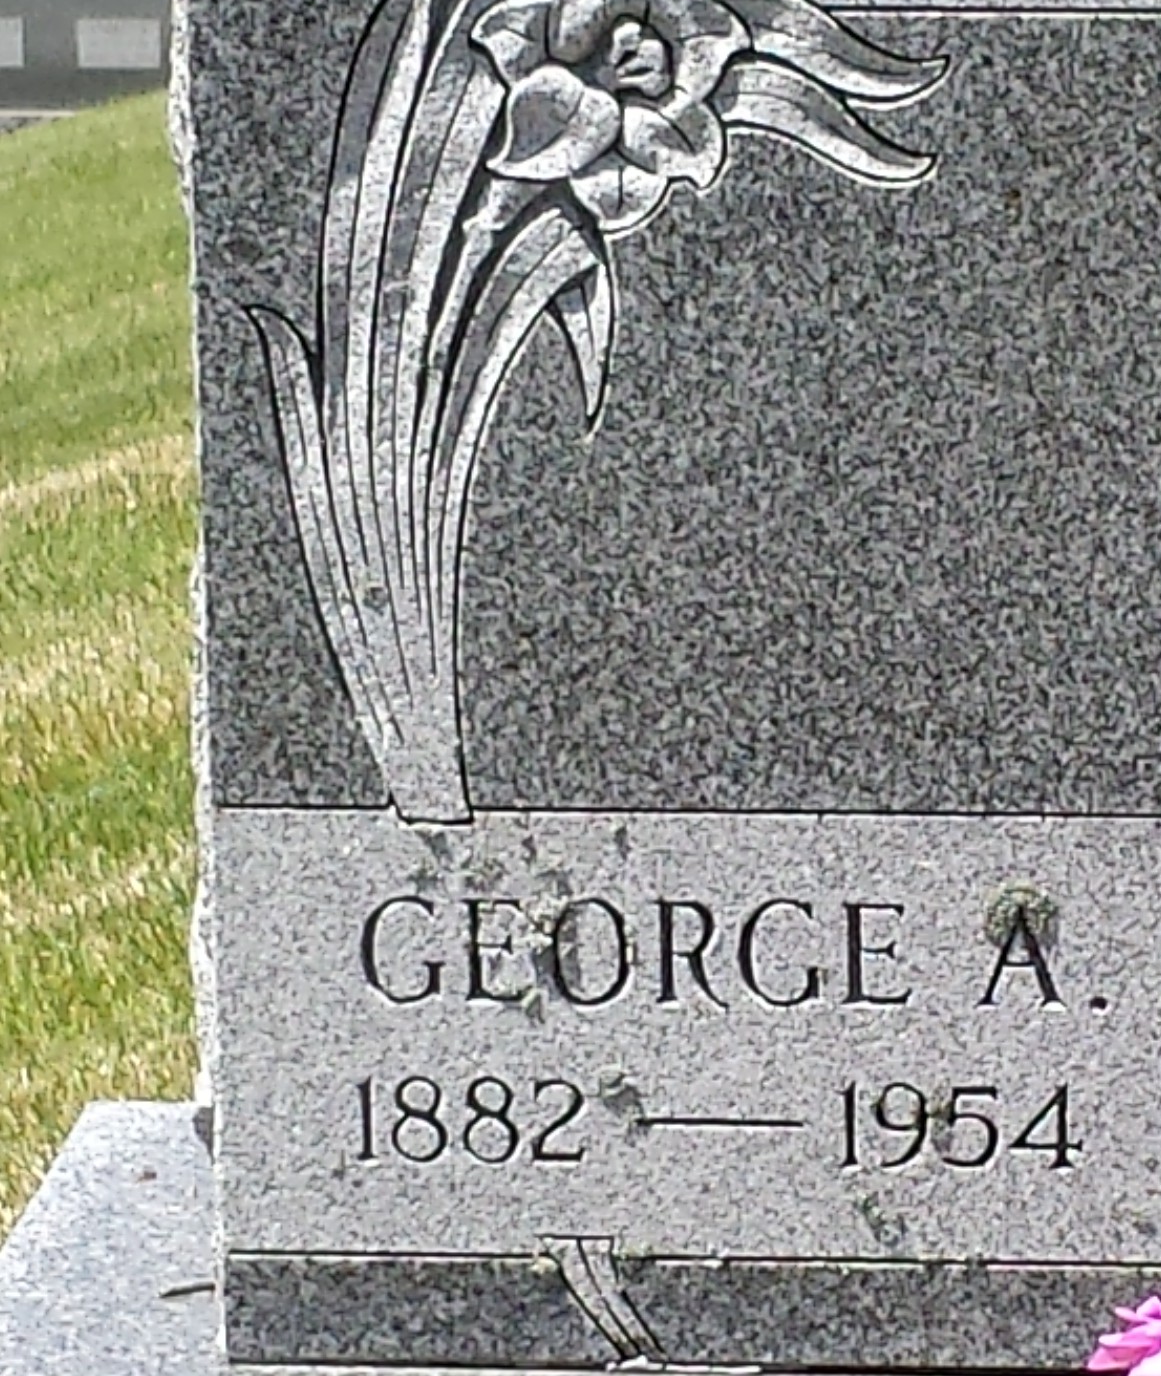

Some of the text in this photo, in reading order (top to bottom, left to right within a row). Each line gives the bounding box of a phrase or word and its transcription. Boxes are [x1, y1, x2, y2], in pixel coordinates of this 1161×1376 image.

[360, 896, 1109, 1010] GEORGE A.
[356, 1075, 587, 1164] 1882
[838, 1080, 1085, 1169] 1954
